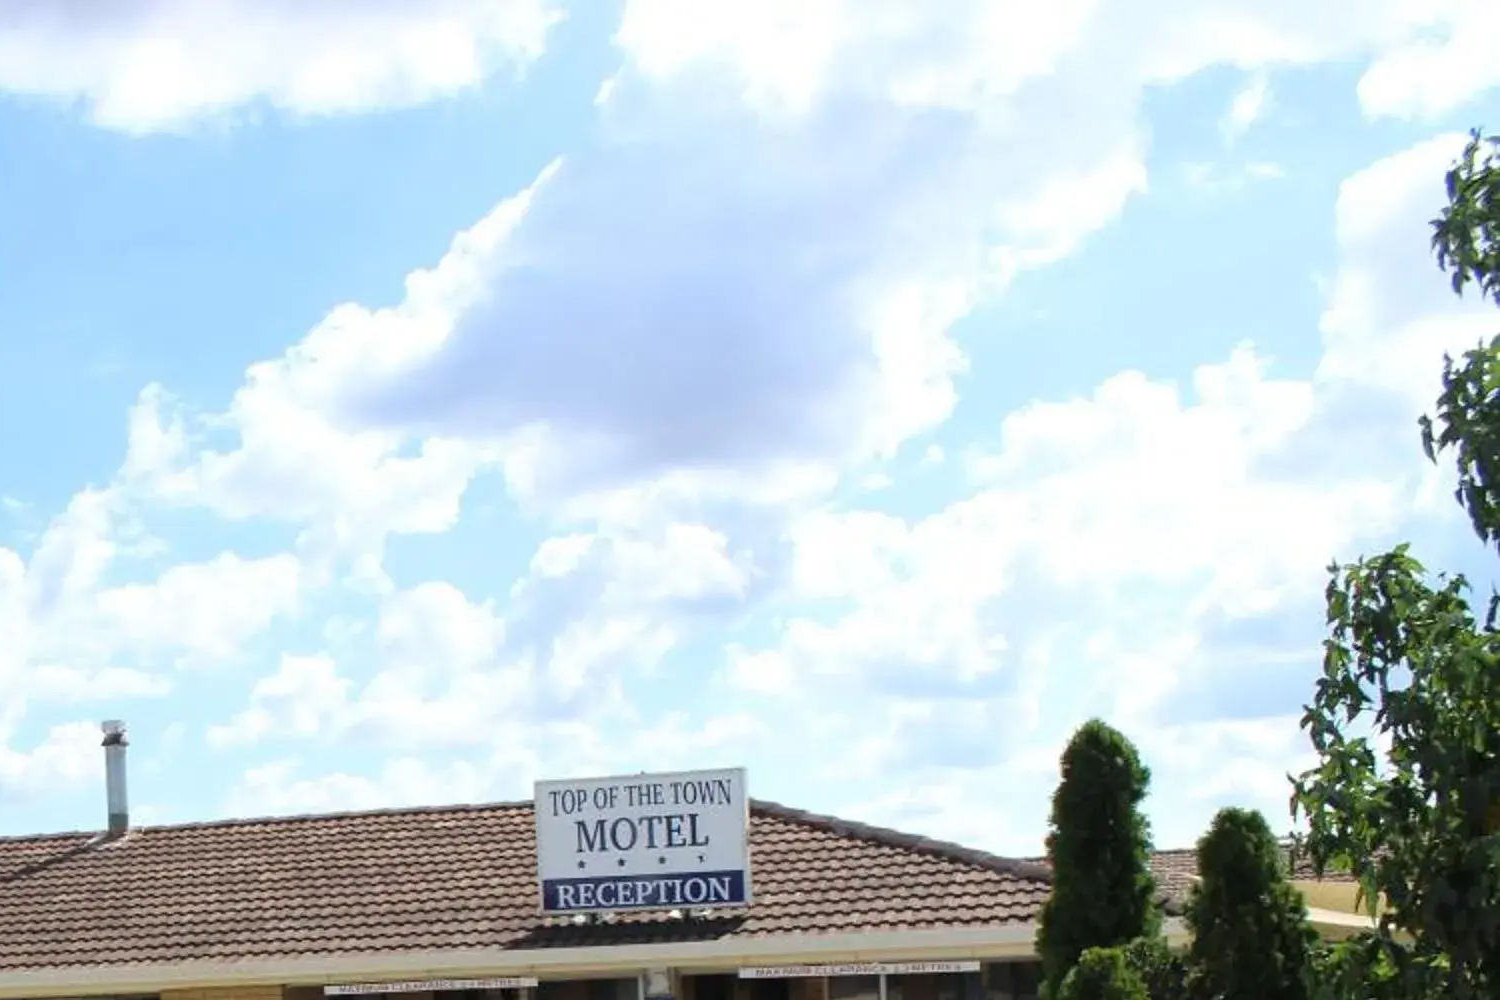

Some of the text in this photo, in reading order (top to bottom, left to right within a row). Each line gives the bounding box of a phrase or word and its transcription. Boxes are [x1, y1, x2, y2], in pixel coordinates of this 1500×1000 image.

[549, 779, 732, 816] TOP OF THE TOWN
[574, 813, 709, 853] MOTEL
[557, 877, 732, 908] RECEPTION
